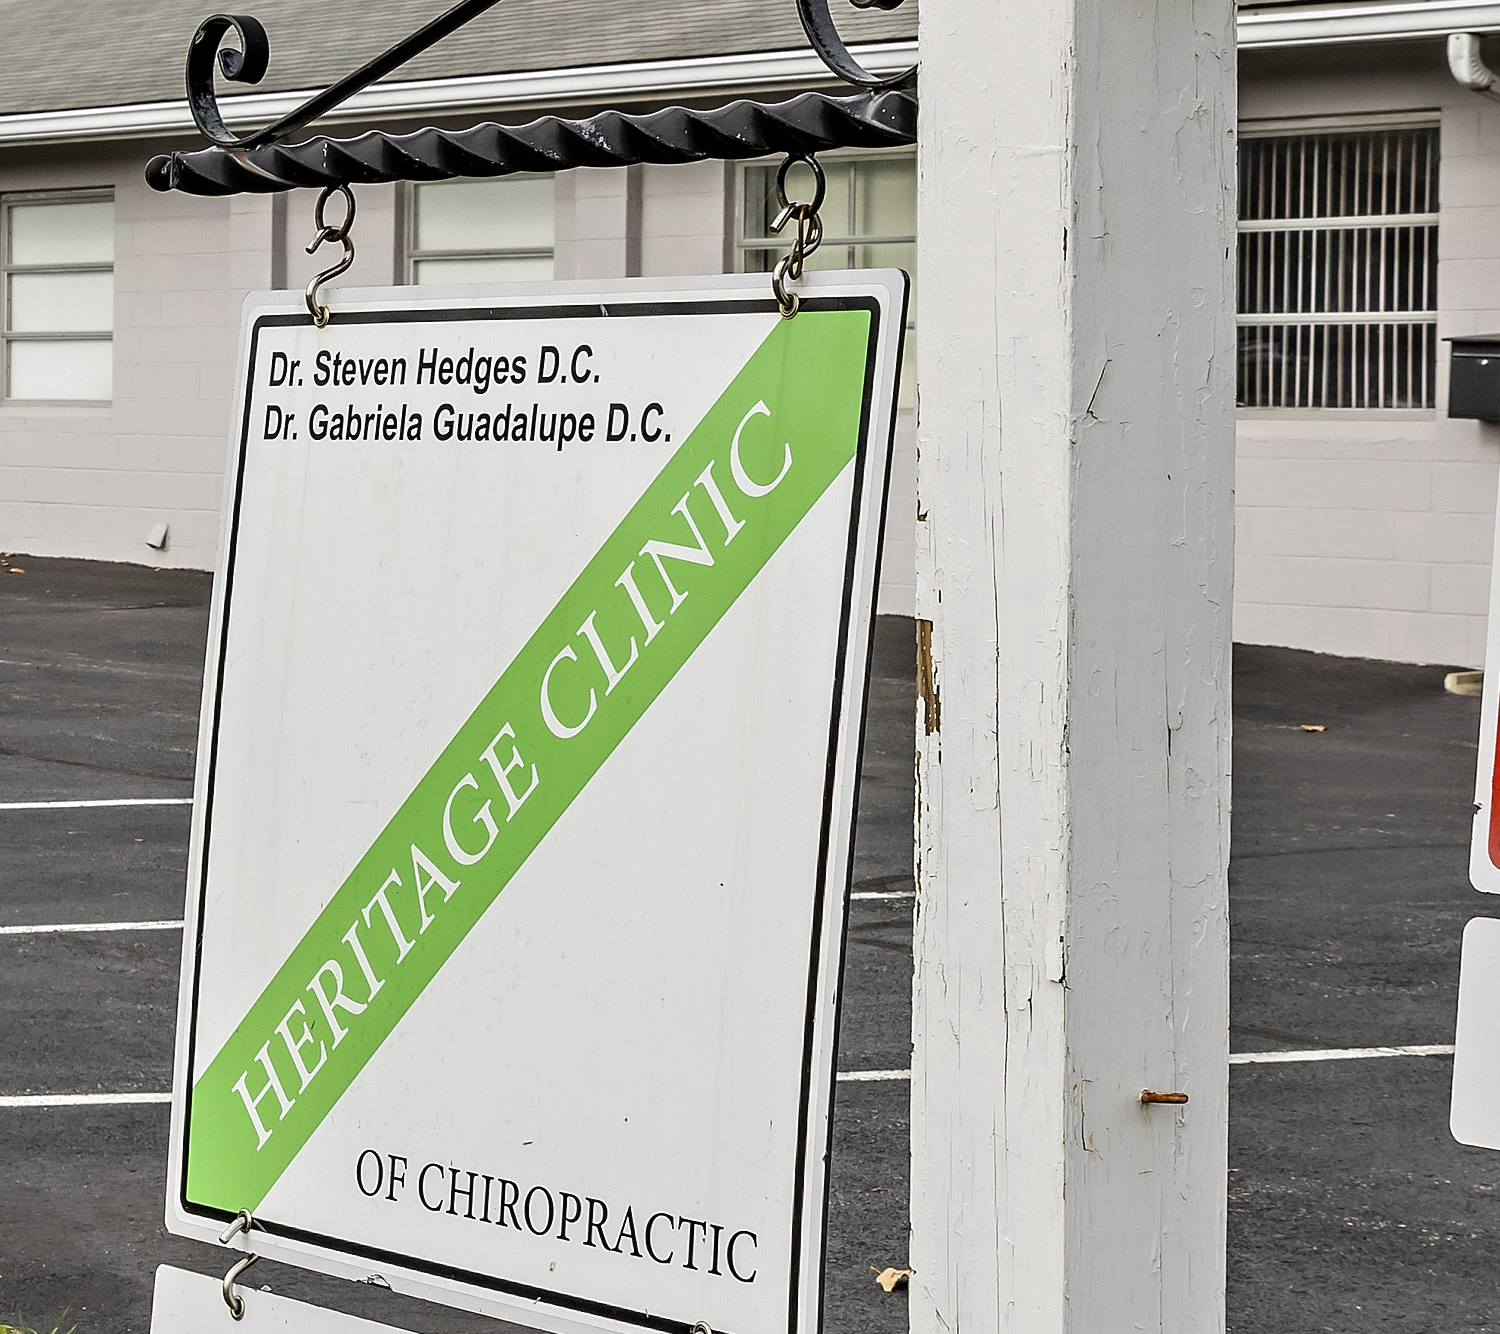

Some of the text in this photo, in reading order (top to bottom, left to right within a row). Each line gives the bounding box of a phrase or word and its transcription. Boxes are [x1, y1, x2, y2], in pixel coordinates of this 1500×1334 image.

[269, 344, 601, 395] Dr. Steven Hedges D.C.
[263, 402, 671, 450] Dr. Gabriela Guadalupe D.C.
[231, 399, 793, 1152] HERITAGE CLINIC
[356, 1149, 758, 1283] OF CHIROPRACTIC
